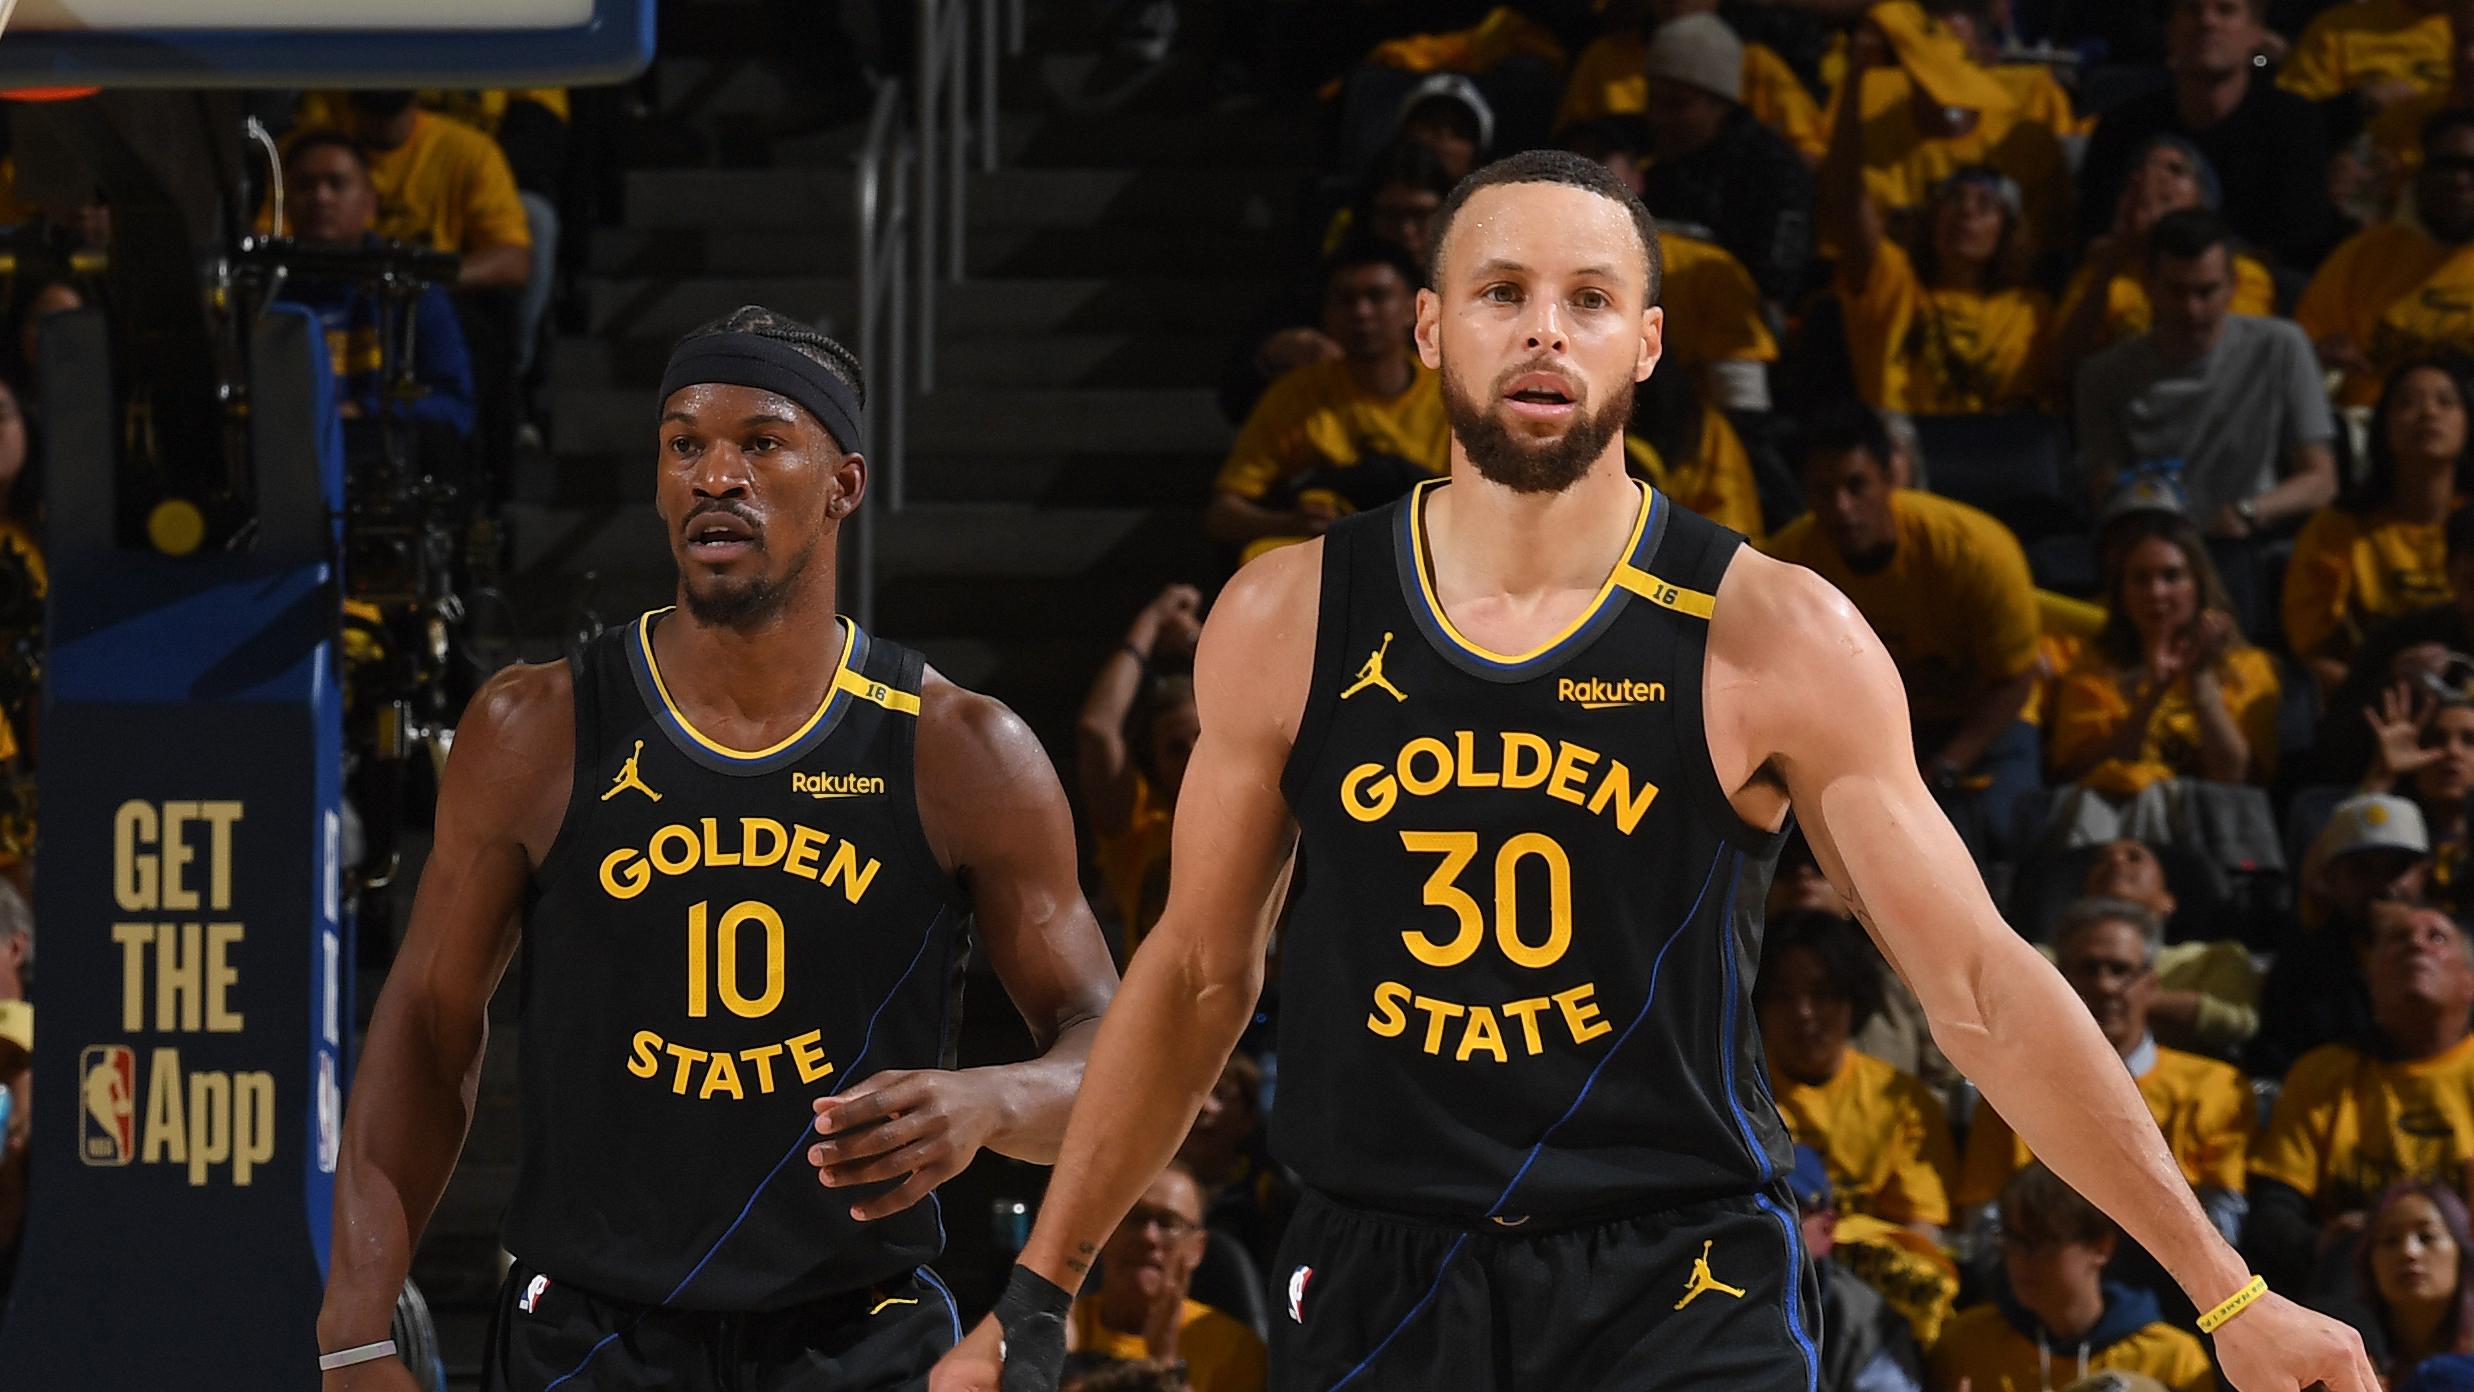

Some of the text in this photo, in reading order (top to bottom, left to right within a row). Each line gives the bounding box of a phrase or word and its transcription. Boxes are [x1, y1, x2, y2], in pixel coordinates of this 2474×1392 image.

[1653, 584, 1678, 605] 16
[866, 684, 886, 701] 16
[1559, 677, 1665, 702] Rakuten
[793, 772, 884, 793] Rakuten
[1341, 731, 1659, 835] GOLDEN
[113, 799, 243, 911] GET
[600, 818, 881, 904] GOLDEN
[1399, 831, 1572, 968] 30
[112, 923, 244, 1032] THE
[688, 900, 785, 1018] 10
[627, 1029, 834, 1100] STATE
[1367, 982, 1612, 1062] STATE
[142, 1047, 275, 1186] App
